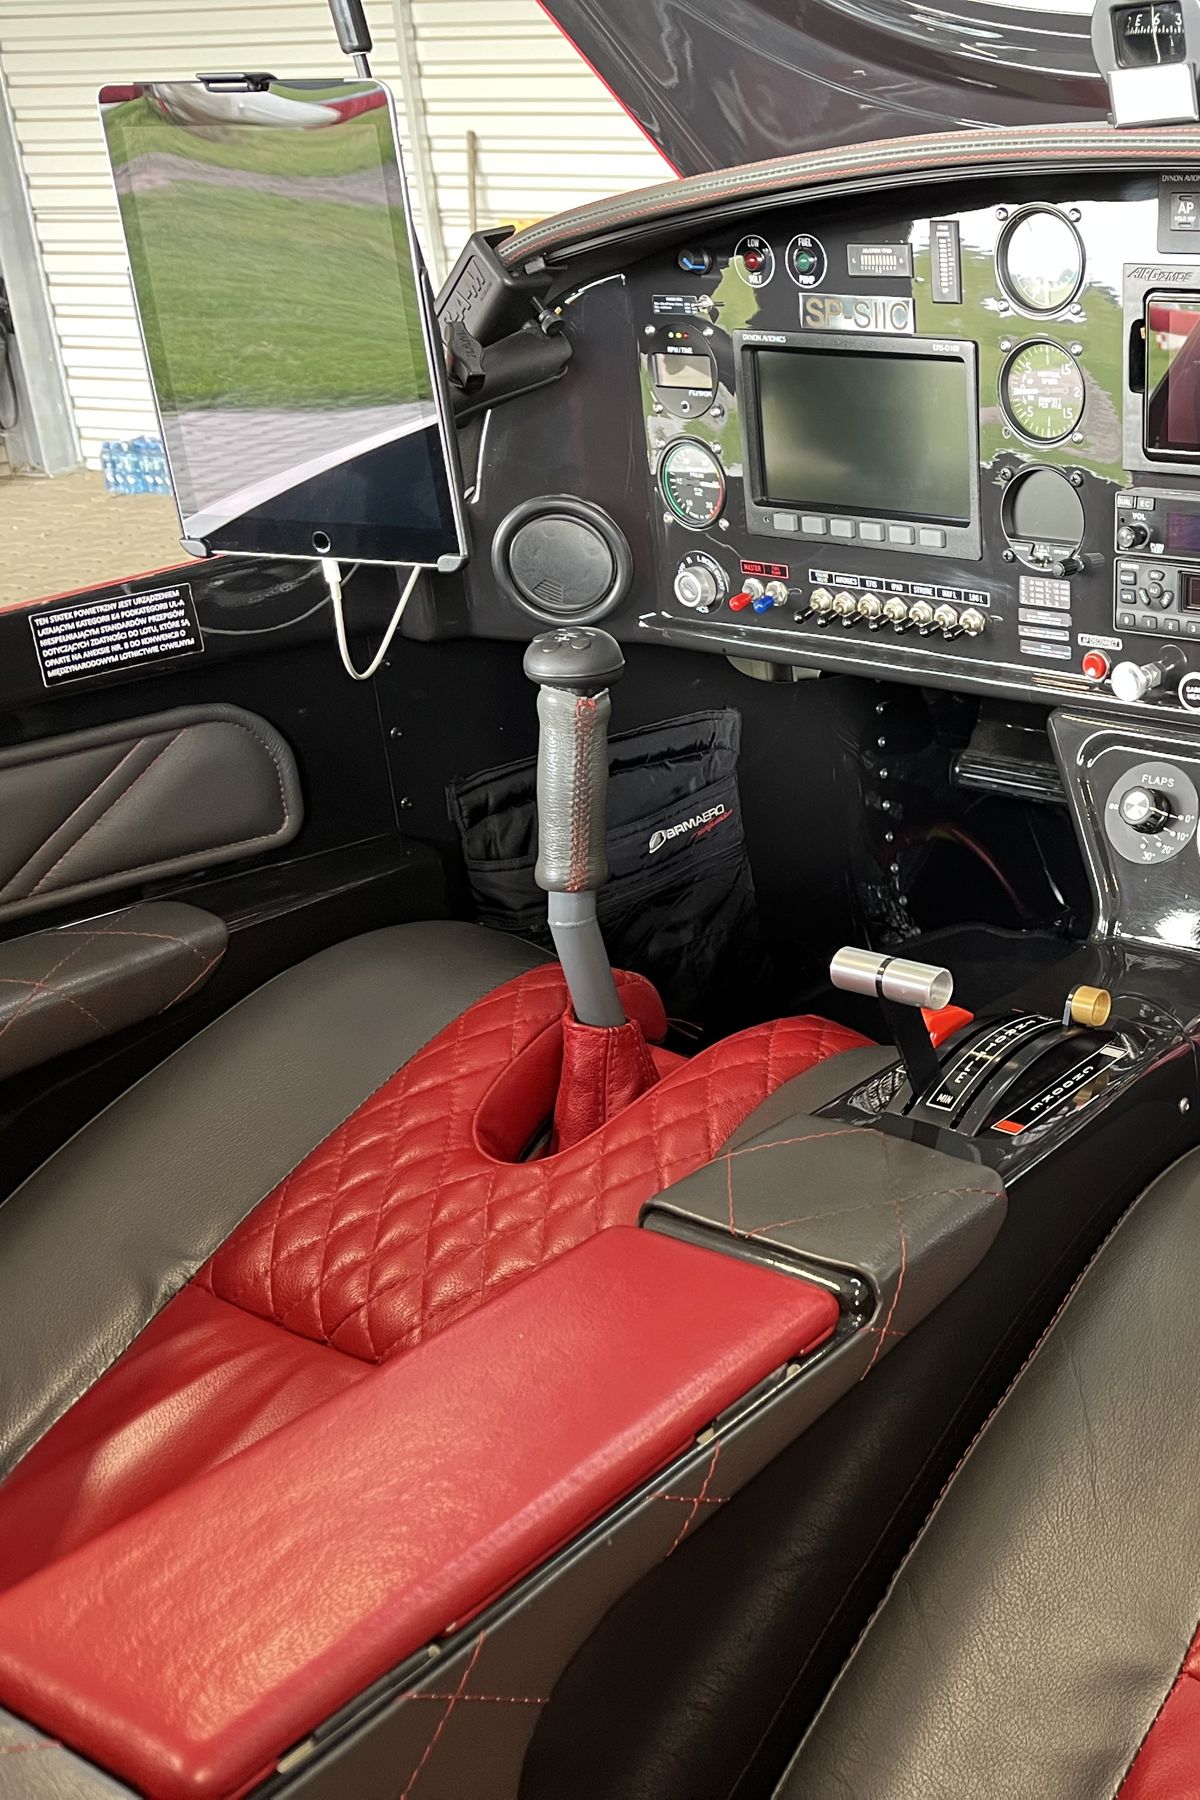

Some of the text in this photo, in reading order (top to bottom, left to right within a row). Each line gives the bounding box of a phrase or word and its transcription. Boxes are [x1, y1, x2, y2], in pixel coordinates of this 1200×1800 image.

[1162, 174, 1184, 182] DYNON
[1177, 202, 1194, 214] AP
[747, 239, 759, 248] LOW
[798, 237, 813, 247] FUEL
[748, 274, 763, 284] VOLT
[798, 274, 816, 285] PUMP
[1132, 512, 1146, 521] VOL
[743, 563, 762, 573] MASTER
[714, 568, 726, 592] START
[835, 575, 858, 586] AVIONICS
[865, 579, 878, 589] EFIS
[890, 583, 903, 592] IPAD
[913, 586, 934, 596] STROBE
[1141, 774, 1175, 788] FLAPS
[666, 803, 725, 840] BRMAERO
[1184, 815, 1195, 824] 0°
[1176, 832, 1190, 841] 10°
[1161, 845, 1175, 855] 20°
[1142, 851, 1155, 861] 30°
[954, 1019, 1036, 1085] THROTTLE
[1030, 1065, 1094, 1111] CHOKE
[936, 1093, 953, 1105] MIN
